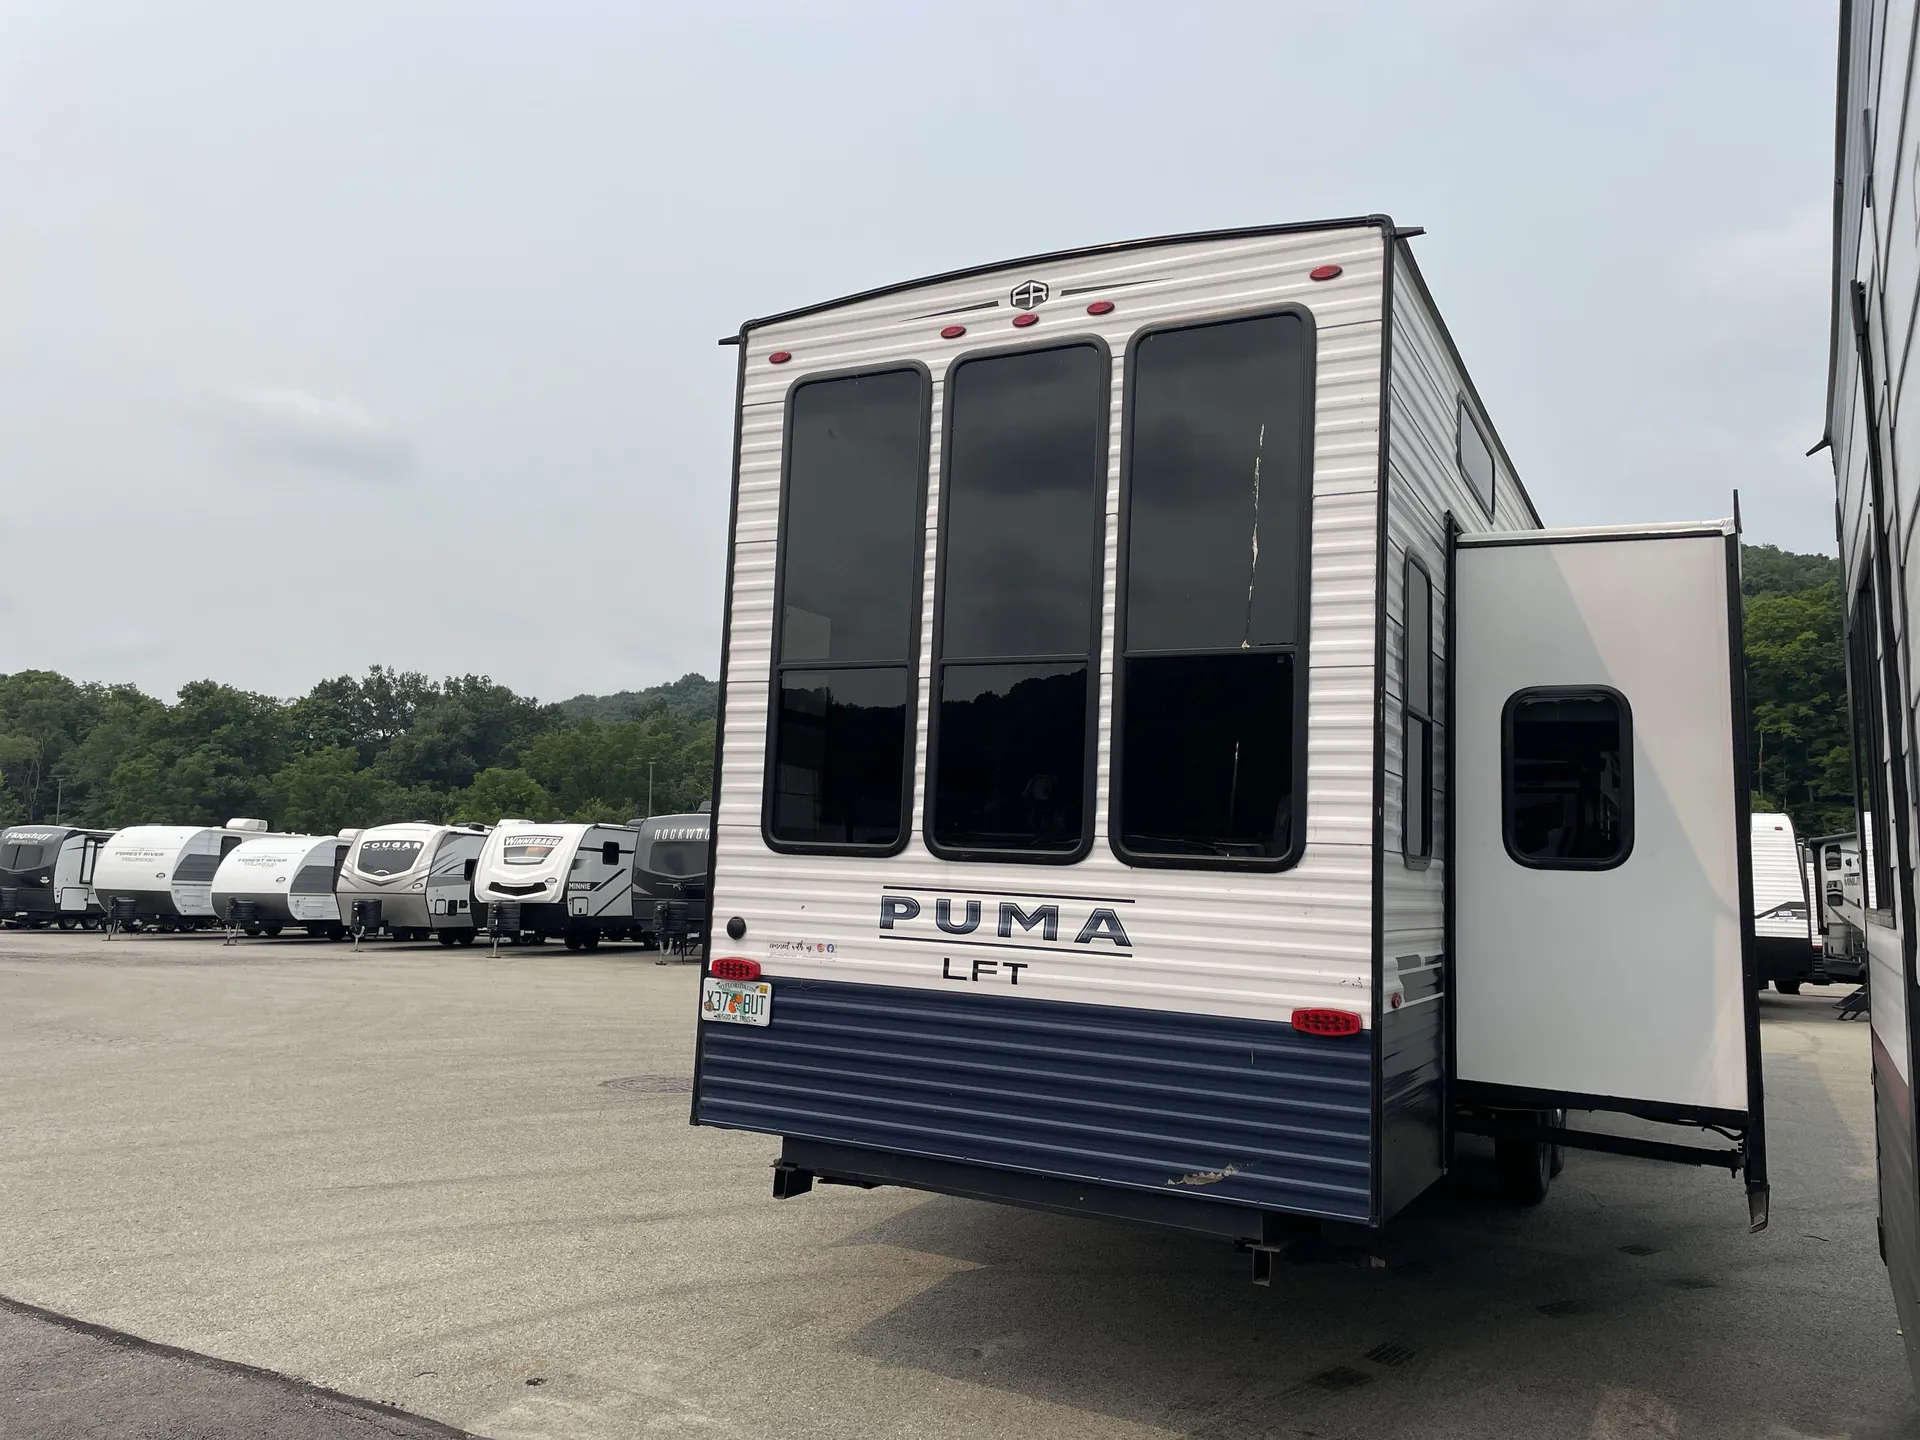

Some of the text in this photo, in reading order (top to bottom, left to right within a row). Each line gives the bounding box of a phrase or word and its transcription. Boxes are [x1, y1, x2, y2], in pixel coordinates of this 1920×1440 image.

[5, 832, 53, 841] Flagstaff
[654, 828, 710, 840] ROCKWOO
[362, 841, 422, 850] COUGAR
[568, 882, 591, 890] MINNIE
[879, 895, 1133, 947] PUMA
[942, 957, 1028, 985] LFT
